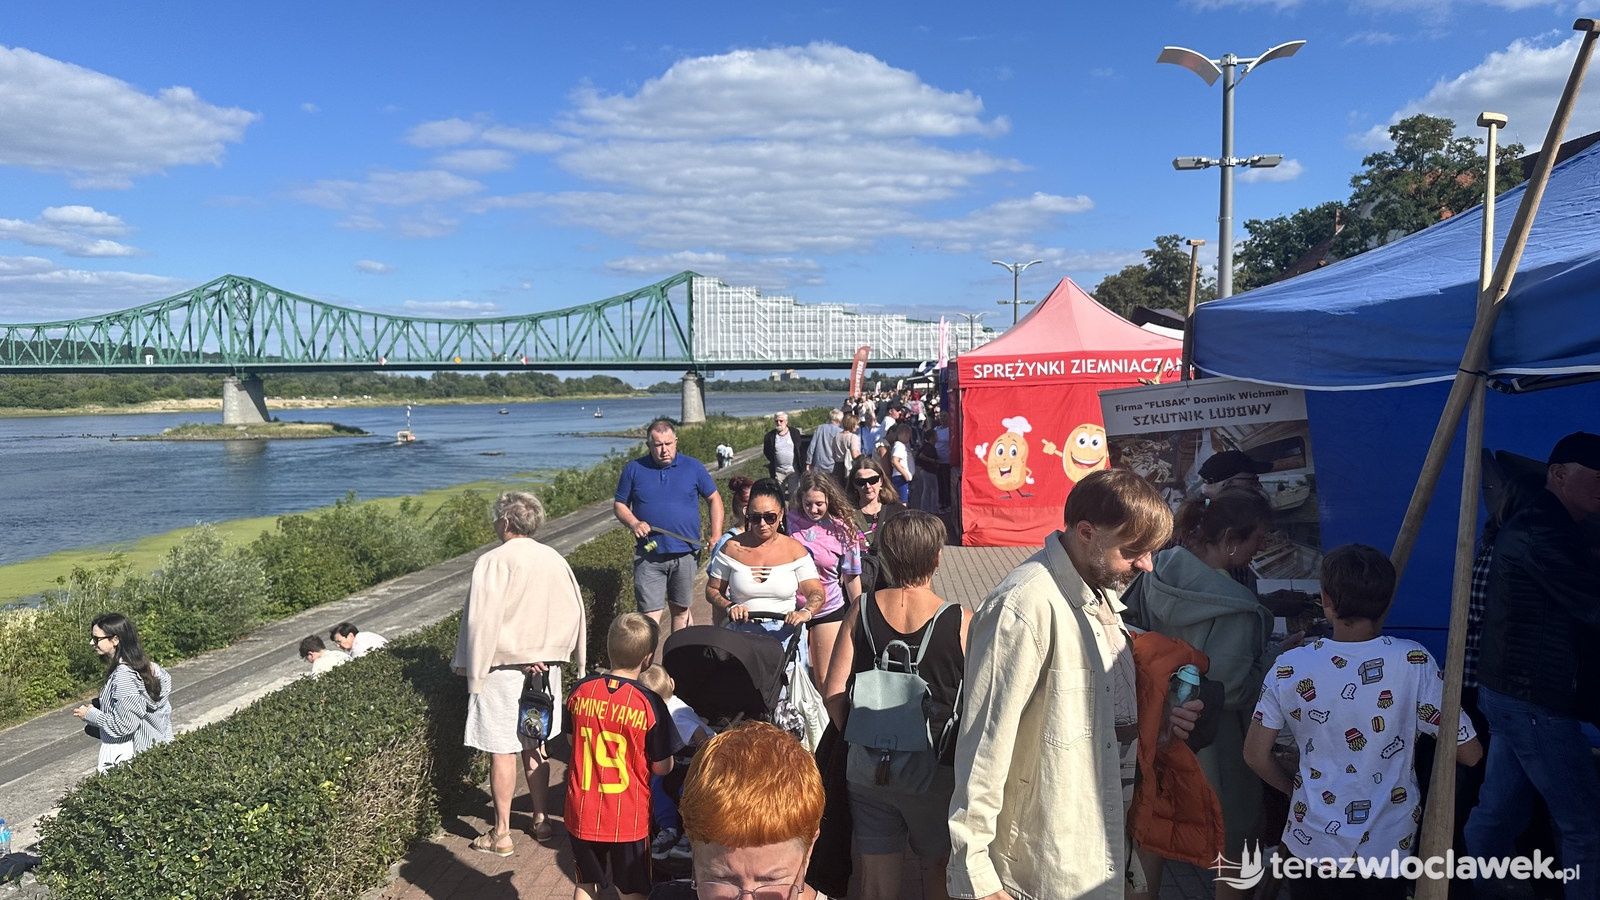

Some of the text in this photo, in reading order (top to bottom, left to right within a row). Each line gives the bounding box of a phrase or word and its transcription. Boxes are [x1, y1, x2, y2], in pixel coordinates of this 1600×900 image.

[973, 359, 1065, 381] SPRĘŻYNKI
[1115, 404, 1143, 412] Firma
[1193, 393, 1236, 404] Dominik
[1238, 388, 1289, 400] Wichman
[1133, 403, 1272, 427] SZKUTNIK LUDOWY
[571, 697, 608, 720] AMINE
[580, 726, 630, 794] 19
